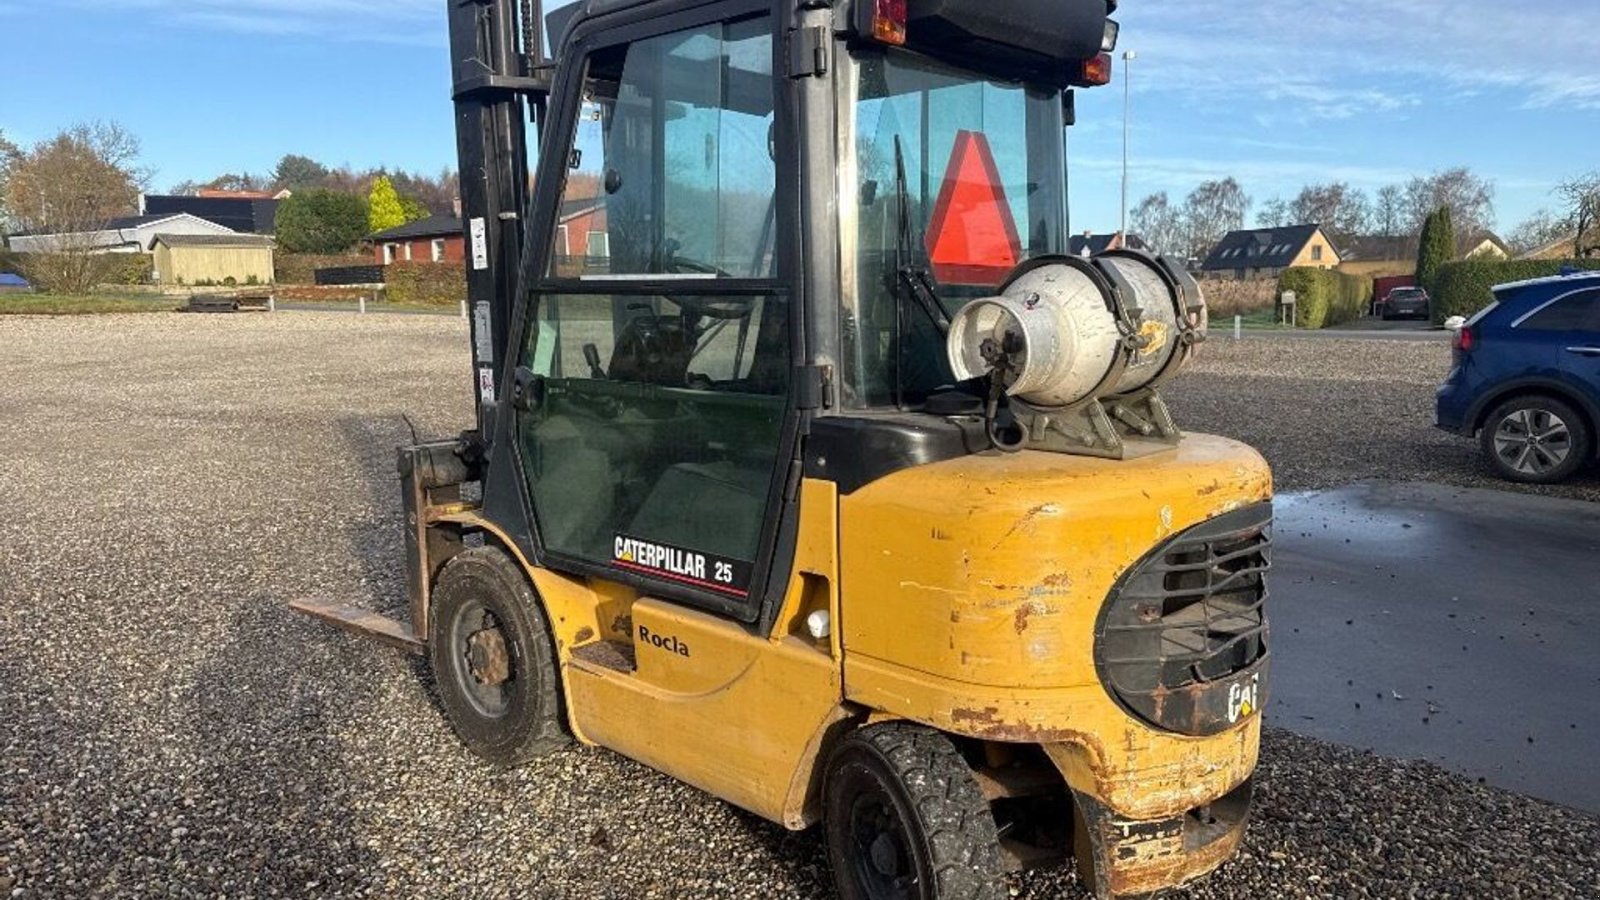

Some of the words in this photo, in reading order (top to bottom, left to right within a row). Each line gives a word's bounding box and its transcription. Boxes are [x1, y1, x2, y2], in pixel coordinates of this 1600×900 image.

[614, 535, 706, 579] CATERPILLAR
[714, 561, 733, 583] 25
[639, 625, 690, 657] Rocla
